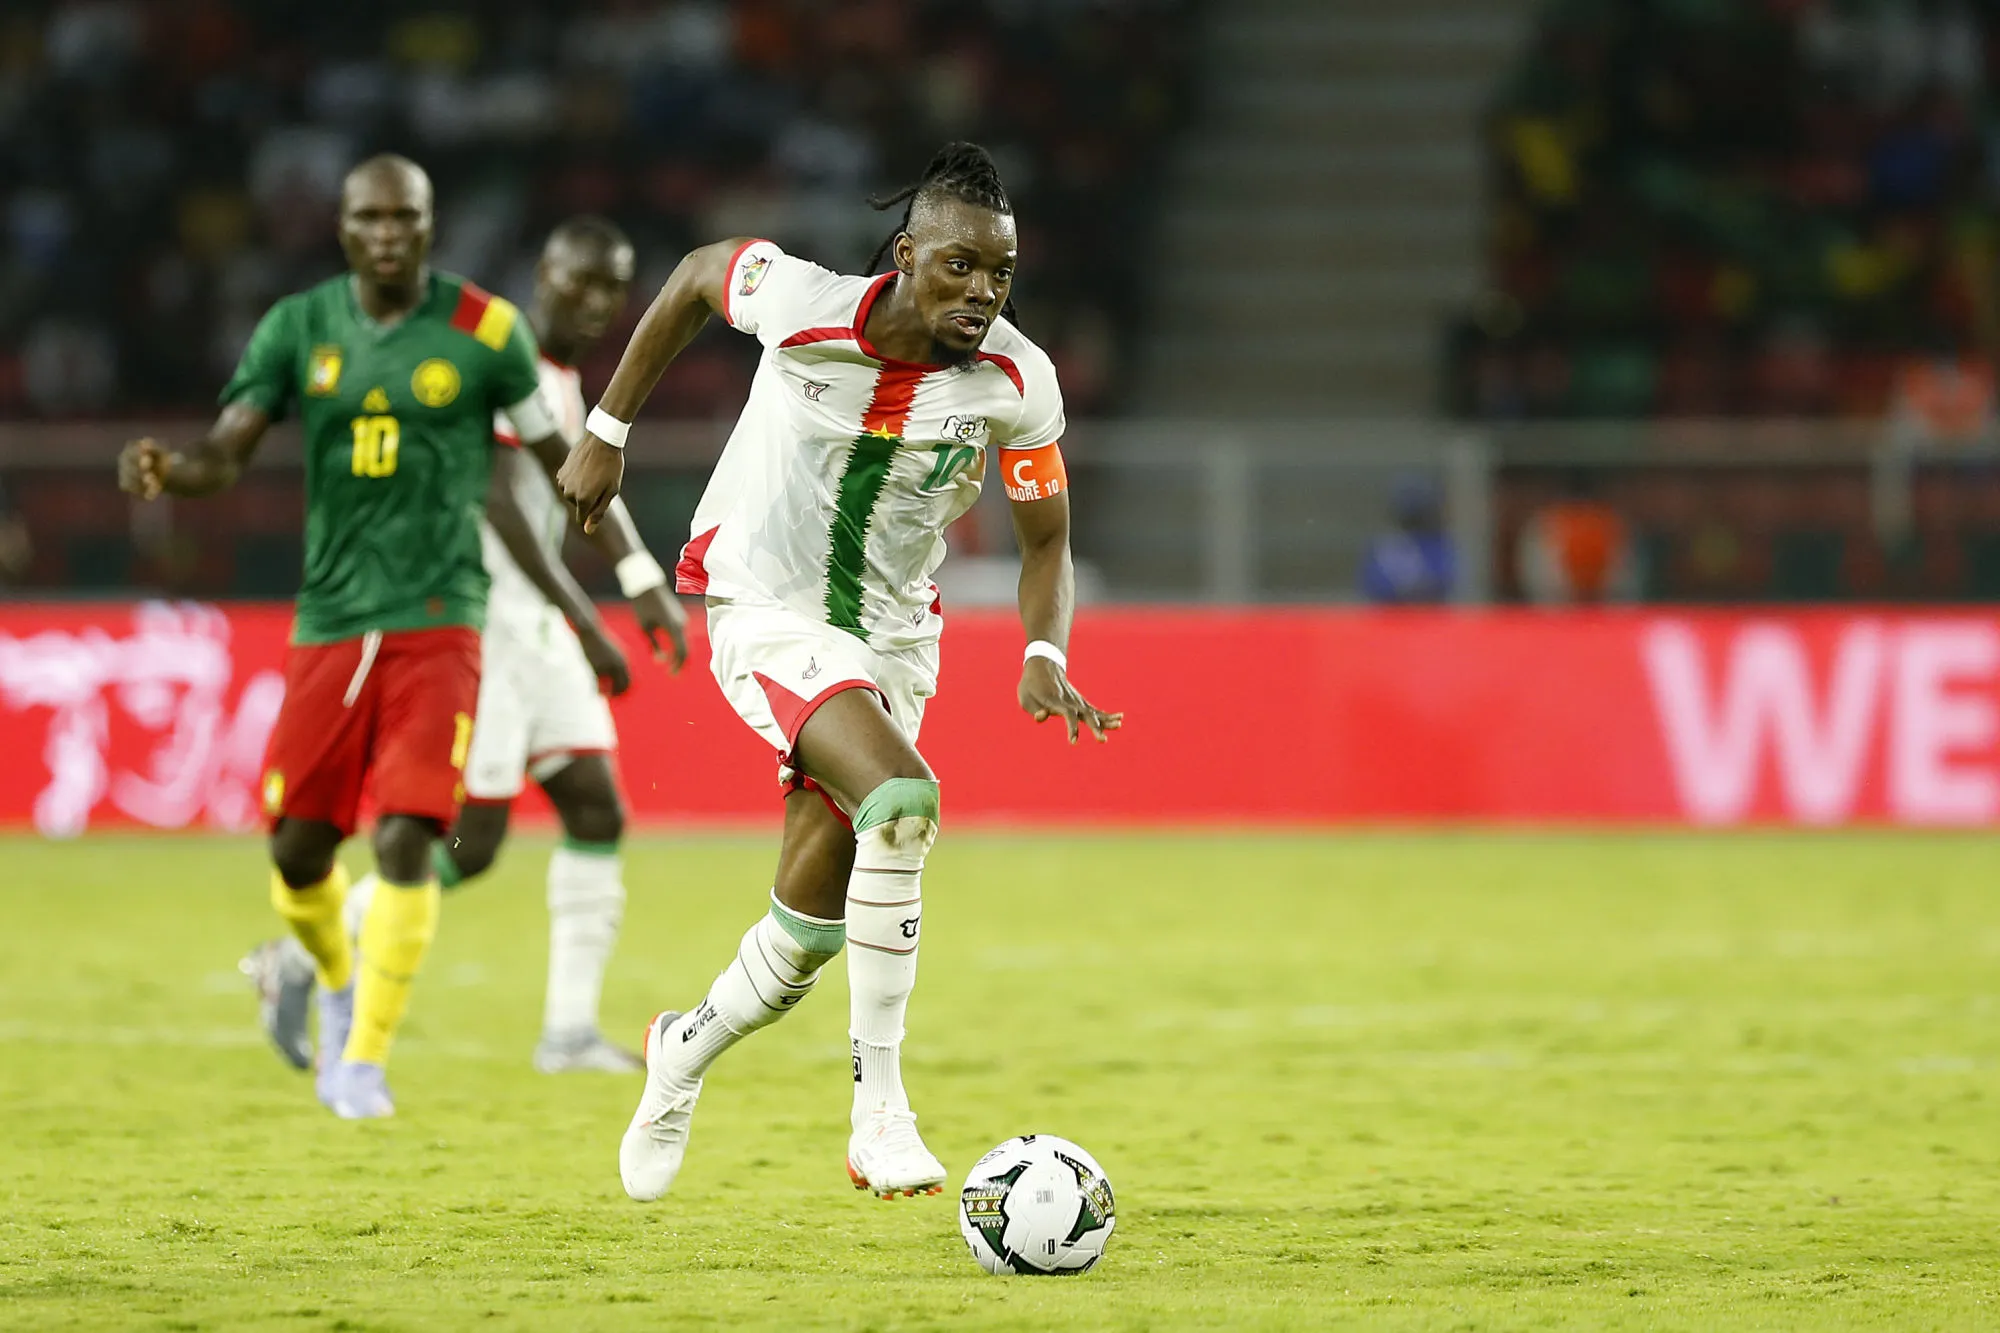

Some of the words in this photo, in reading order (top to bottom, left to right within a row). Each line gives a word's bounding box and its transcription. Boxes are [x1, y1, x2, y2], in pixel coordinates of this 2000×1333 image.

[351, 415, 400, 477] 10
[920, 444, 976, 491] 10
[1013, 459, 1036, 487] C
[1045, 479, 1059, 496] 10
[1640, 616, 1999, 825] WE
